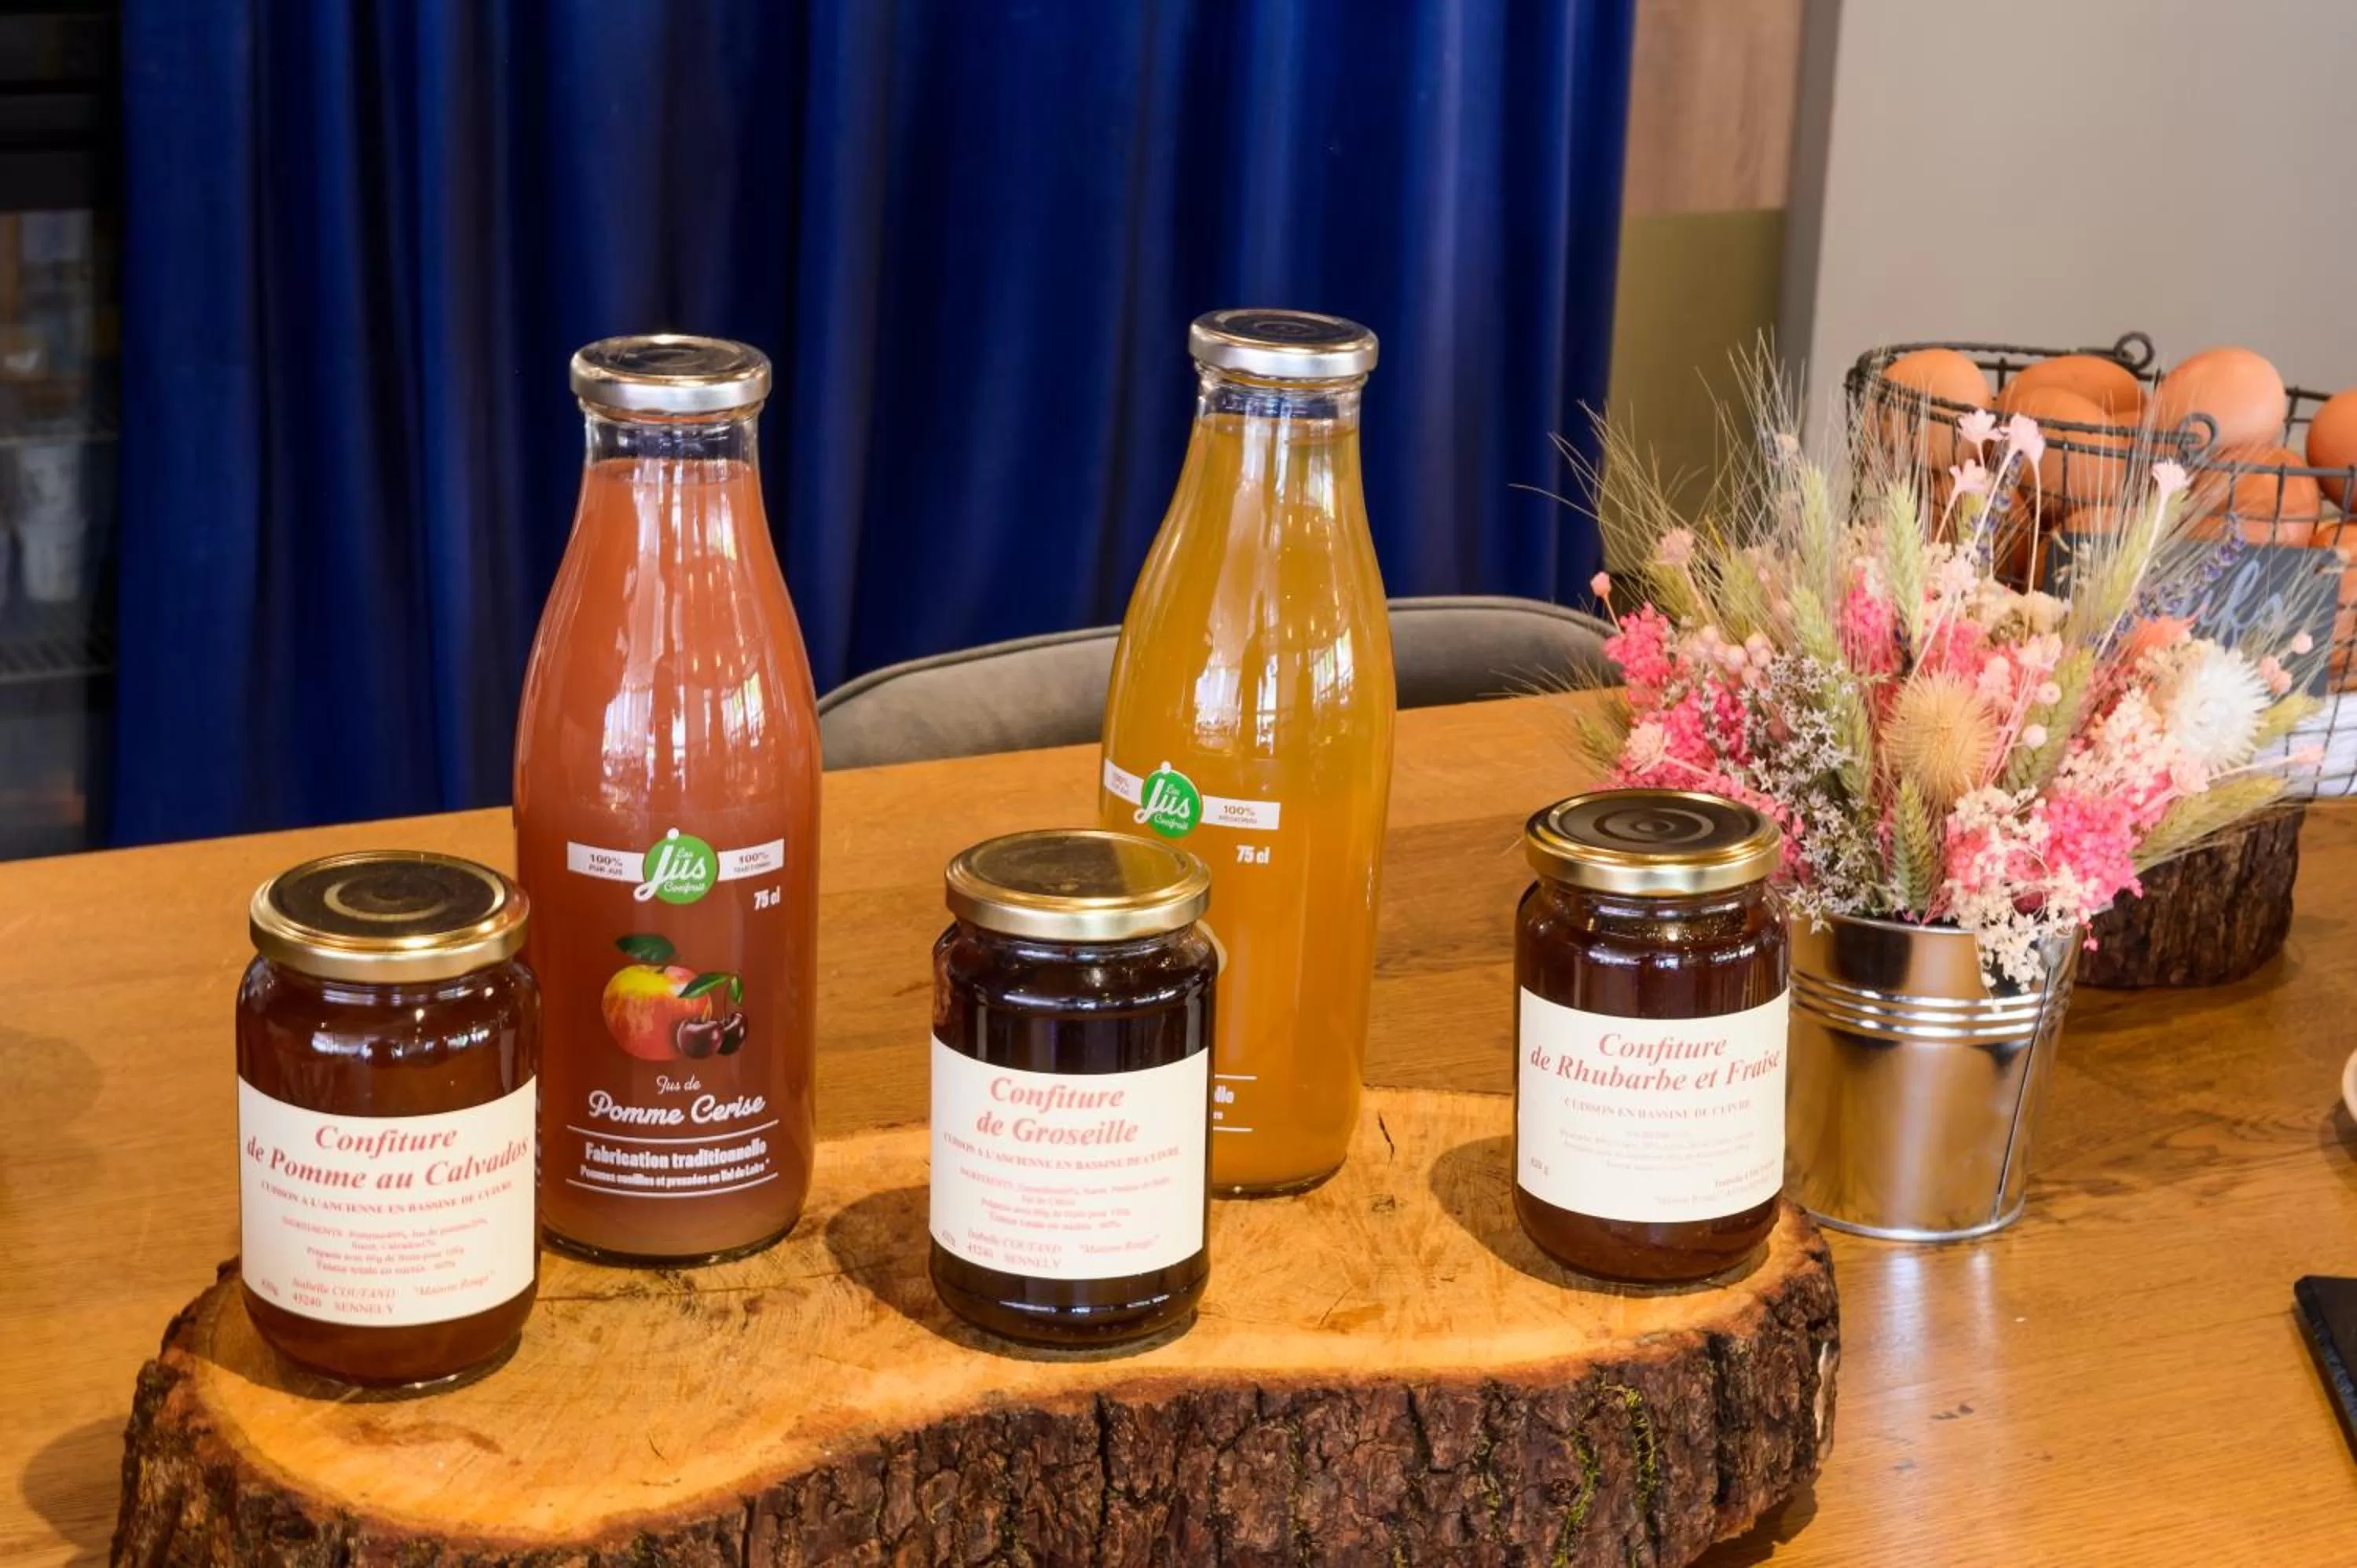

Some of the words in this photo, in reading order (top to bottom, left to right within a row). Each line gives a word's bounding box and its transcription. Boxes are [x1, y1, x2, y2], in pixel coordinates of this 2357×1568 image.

[589, 854, 622, 866] 100%
[739, 852, 769, 863] 100%
[1237, 844, 1255, 863] 75
[754, 888, 769, 911] 75
[1599, 1033, 1728, 1066] Confiture
[656, 1075, 680, 1094] Jus
[684, 1074, 702, 1092] de
[1530, 1046, 1551, 1071] de
[1556, 1054, 1686, 1091] Rhubarbe
[1695, 1068, 1717, 1090] et
[1726, 1050, 1781, 1085] Fraise
[588, 1090, 684, 1125] Pomme
[691, 1094, 765, 1124] Cerise
[991, 1076, 1125, 1114] Confiture
[315, 1125, 457, 1159] Confiture
[976, 1111, 1003, 1137] de
[1012, 1116, 1139, 1146] Groseille
[247, 1136, 264, 1163] de
[270, 1148, 366, 1189] Pomme
[376, 1170, 412, 1189] au
[425, 1136, 529, 1186] Calvados
[585, 1141, 669, 1169] Fabrication
[672, 1137, 767, 1169] traditionnelle
